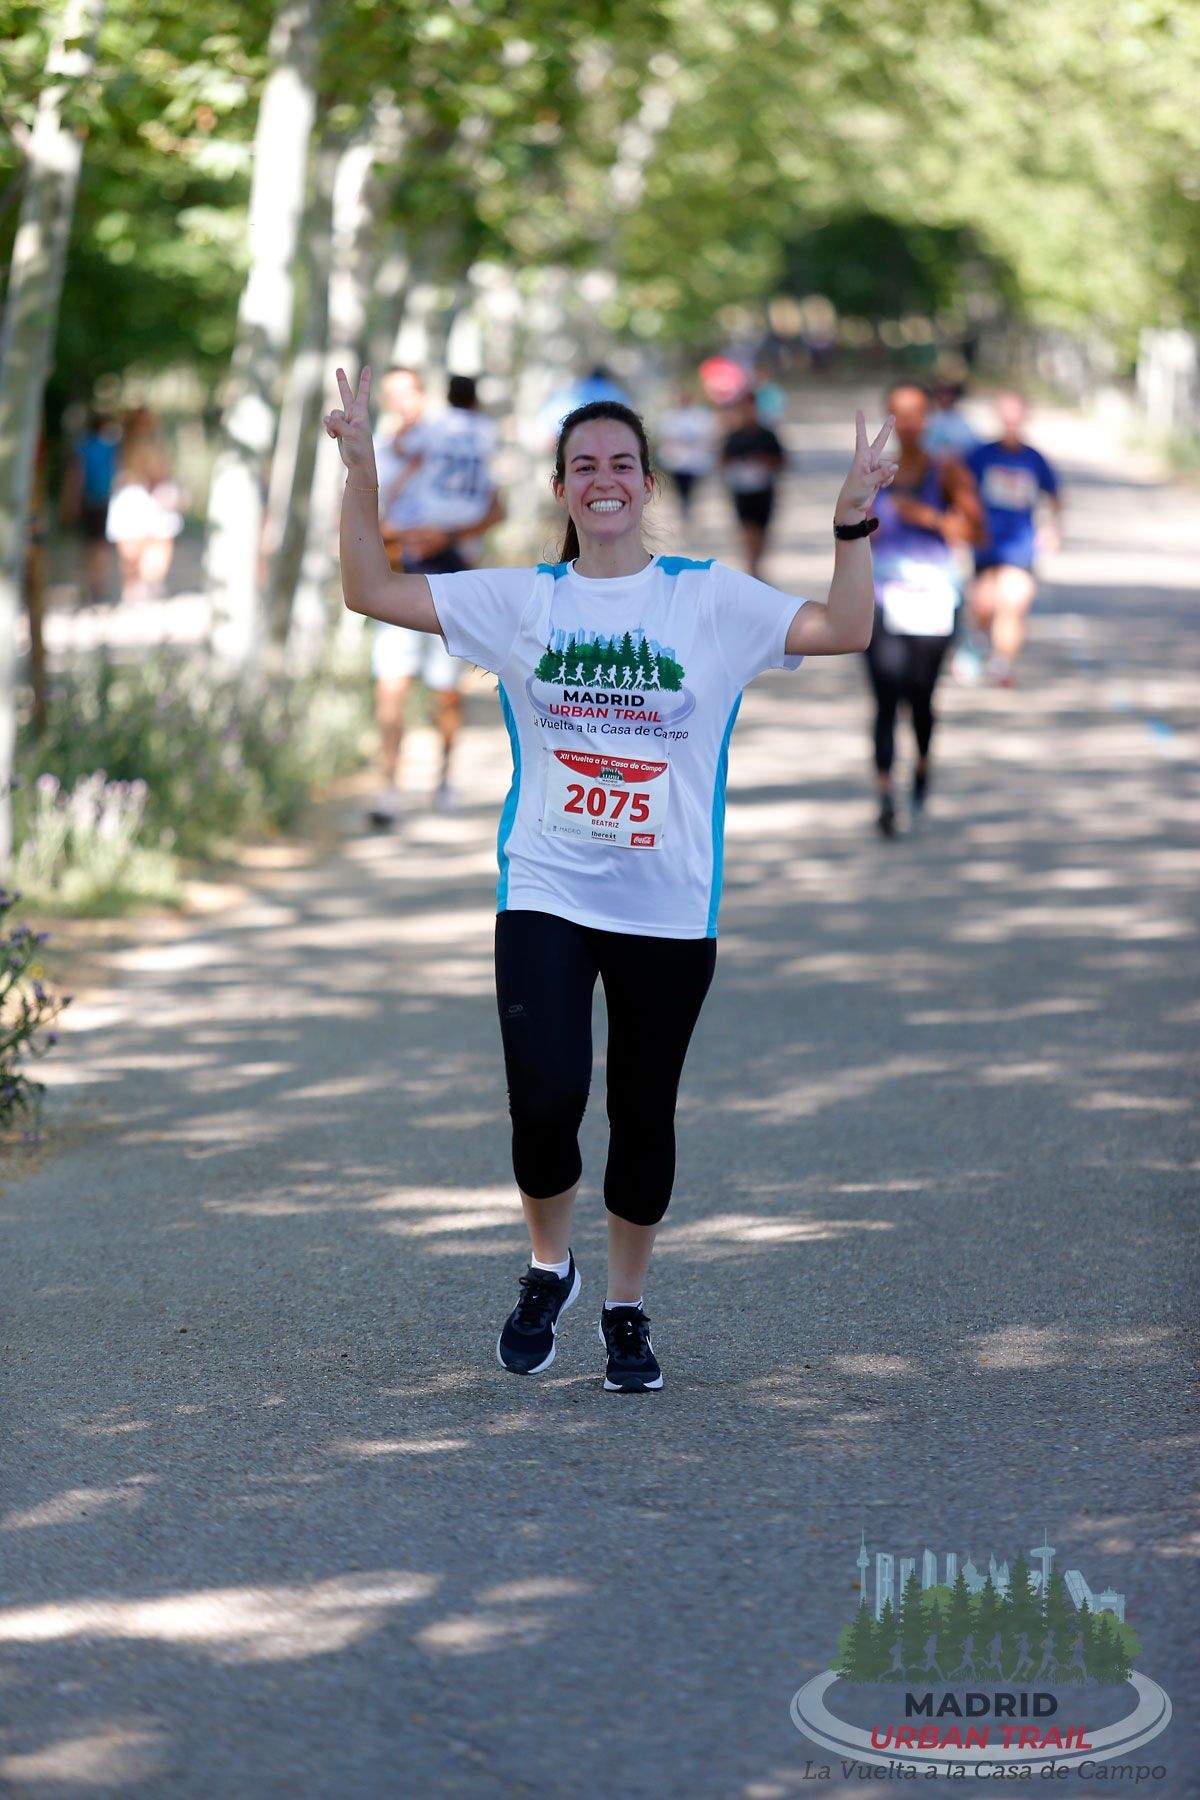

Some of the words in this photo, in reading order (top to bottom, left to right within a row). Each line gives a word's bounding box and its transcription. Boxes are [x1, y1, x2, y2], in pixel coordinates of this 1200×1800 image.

[563, 689, 645, 707] MADRID
[549, 704, 609, 719] URBAN
[614, 708, 661, 723] TRAIL
[540, 717, 575, 731] Vuelta
[576, 724, 583, 733] a
[586, 722, 597, 734] la
[600, 723, 631, 735] Casa
[634, 725, 650, 736] de
[560, 753, 570, 761] XII
[571, 754, 594, 764] Vuelta
[601, 758, 608, 766] la
[610, 760, 629, 769] Casa
[629, 762, 640, 770] de
[640, 764, 663, 773] Campo
[563, 783, 650, 823] 2075
[591, 819, 620, 829] BEATRIZ
